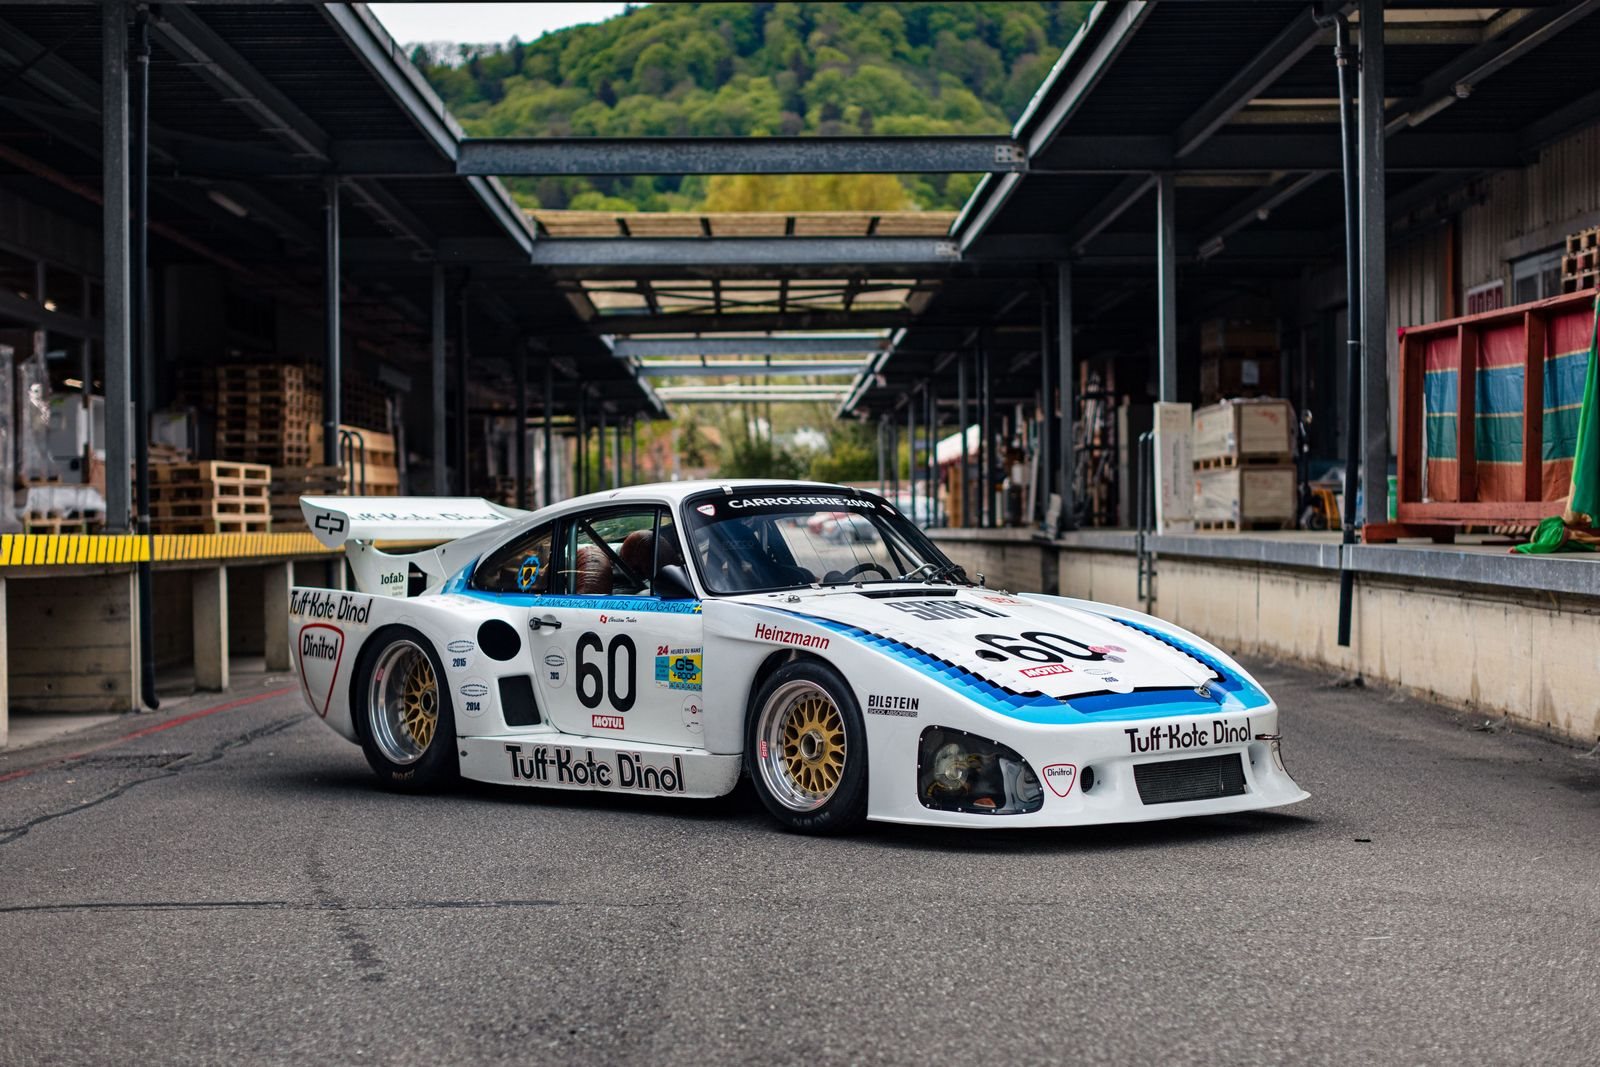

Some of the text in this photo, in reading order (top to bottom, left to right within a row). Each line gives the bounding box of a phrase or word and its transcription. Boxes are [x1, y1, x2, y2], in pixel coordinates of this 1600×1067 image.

[728, 497, 876, 509] CARROSSERIE 2000
[380, 573, 405, 585] lofab
[337, 595, 371, 623] Dinol
[600, 600, 630, 610] WILDS
[631, 601, 692, 613] LUNDGARDH
[755, 623, 830, 650] Heinzmann
[303, 634, 339, 661] Dinitrol
[657, 645, 669, 655] 24
[974, 631, 1108, 664] 60
[452, 658, 466, 667] 2015
[675, 658, 694, 671] G5
[575, 631, 637, 712] 60
[1025, 667, 1070, 677] MOTUL
[466, 702, 480, 711] 2014
[868, 695, 919, 710] BILSTEIN
[593, 716, 624, 728] MOTUL
[1124, 718, 1252, 753] Tuff-Kote Dinol
[505, 744, 684, 792] Tuff-Kote Dinol
[1047, 768, 1073, 776] Dinitrol
